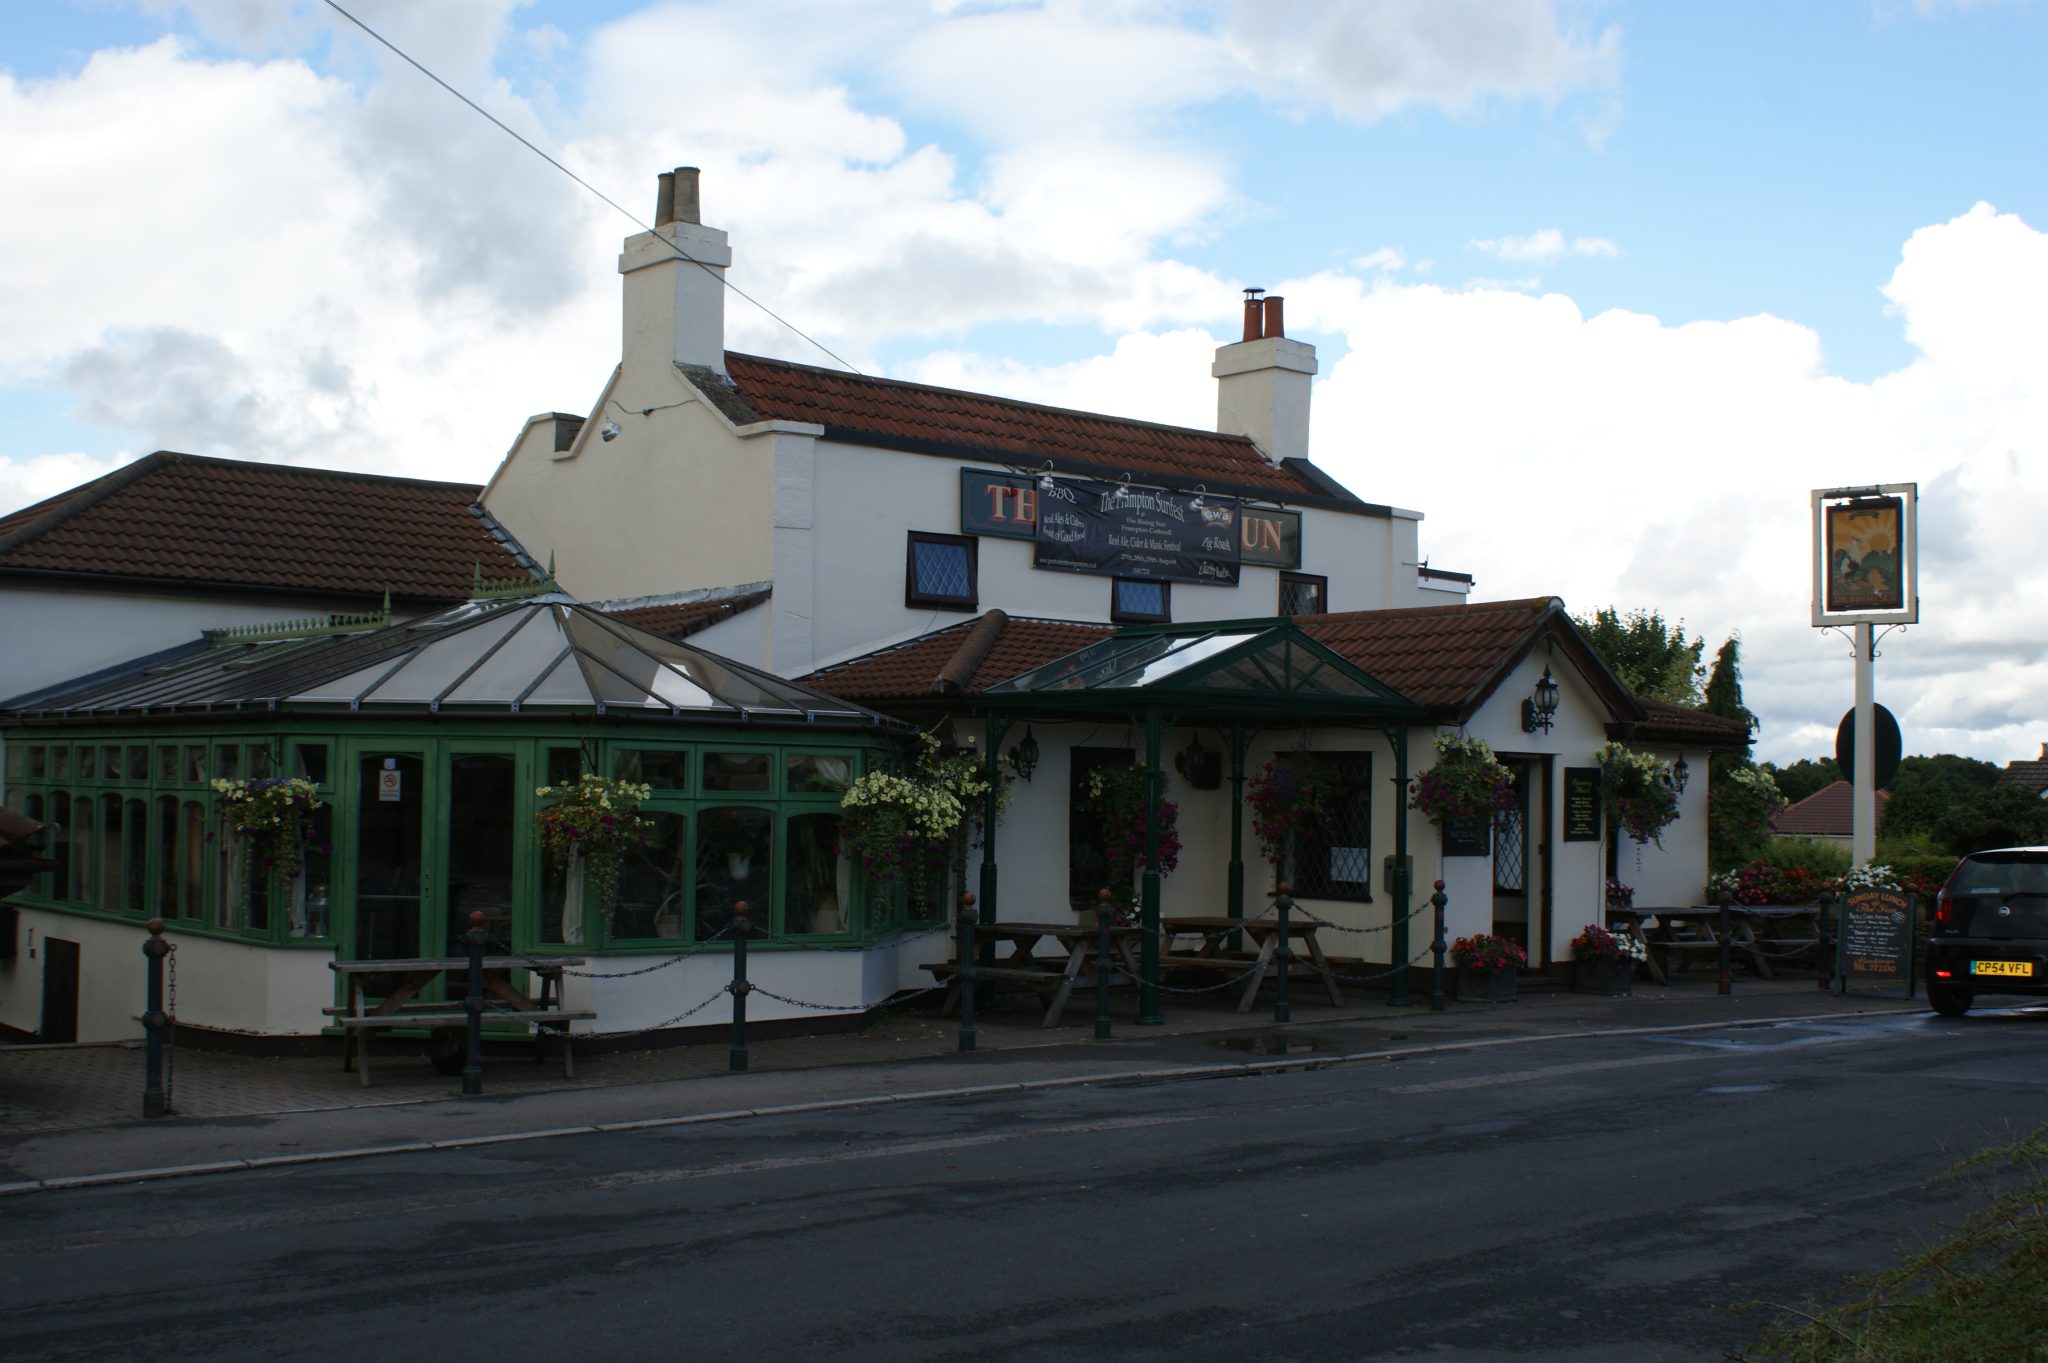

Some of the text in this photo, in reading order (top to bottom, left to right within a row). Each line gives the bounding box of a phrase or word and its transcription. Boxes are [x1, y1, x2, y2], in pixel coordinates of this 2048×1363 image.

[988, 484, 1037, 522] TH
[1048, 487, 1077, 504] BBQ
[1100, 491, 1115, 513] The
[1156, 492, 1185, 523] Sunfest
[1204, 511, 1229, 521] GWB
[1060, 530, 1074, 542] Good
[1121, 525, 1149, 534] Frampton
[1241, 517, 1283, 551] UN
[1108, 534, 1120, 546] Real
[1130, 537, 1144, 548] Cider
[1149, 538, 1163, 550] Music
[1163, 540, 1182, 552] Festival
[1213, 536, 1231, 551] Roast
[1847, 892, 1879, 906] SUNDAY
[1881, 893, 1908, 908] LUNCH
[1977, 962, 2030, 974] CP54 VFL
